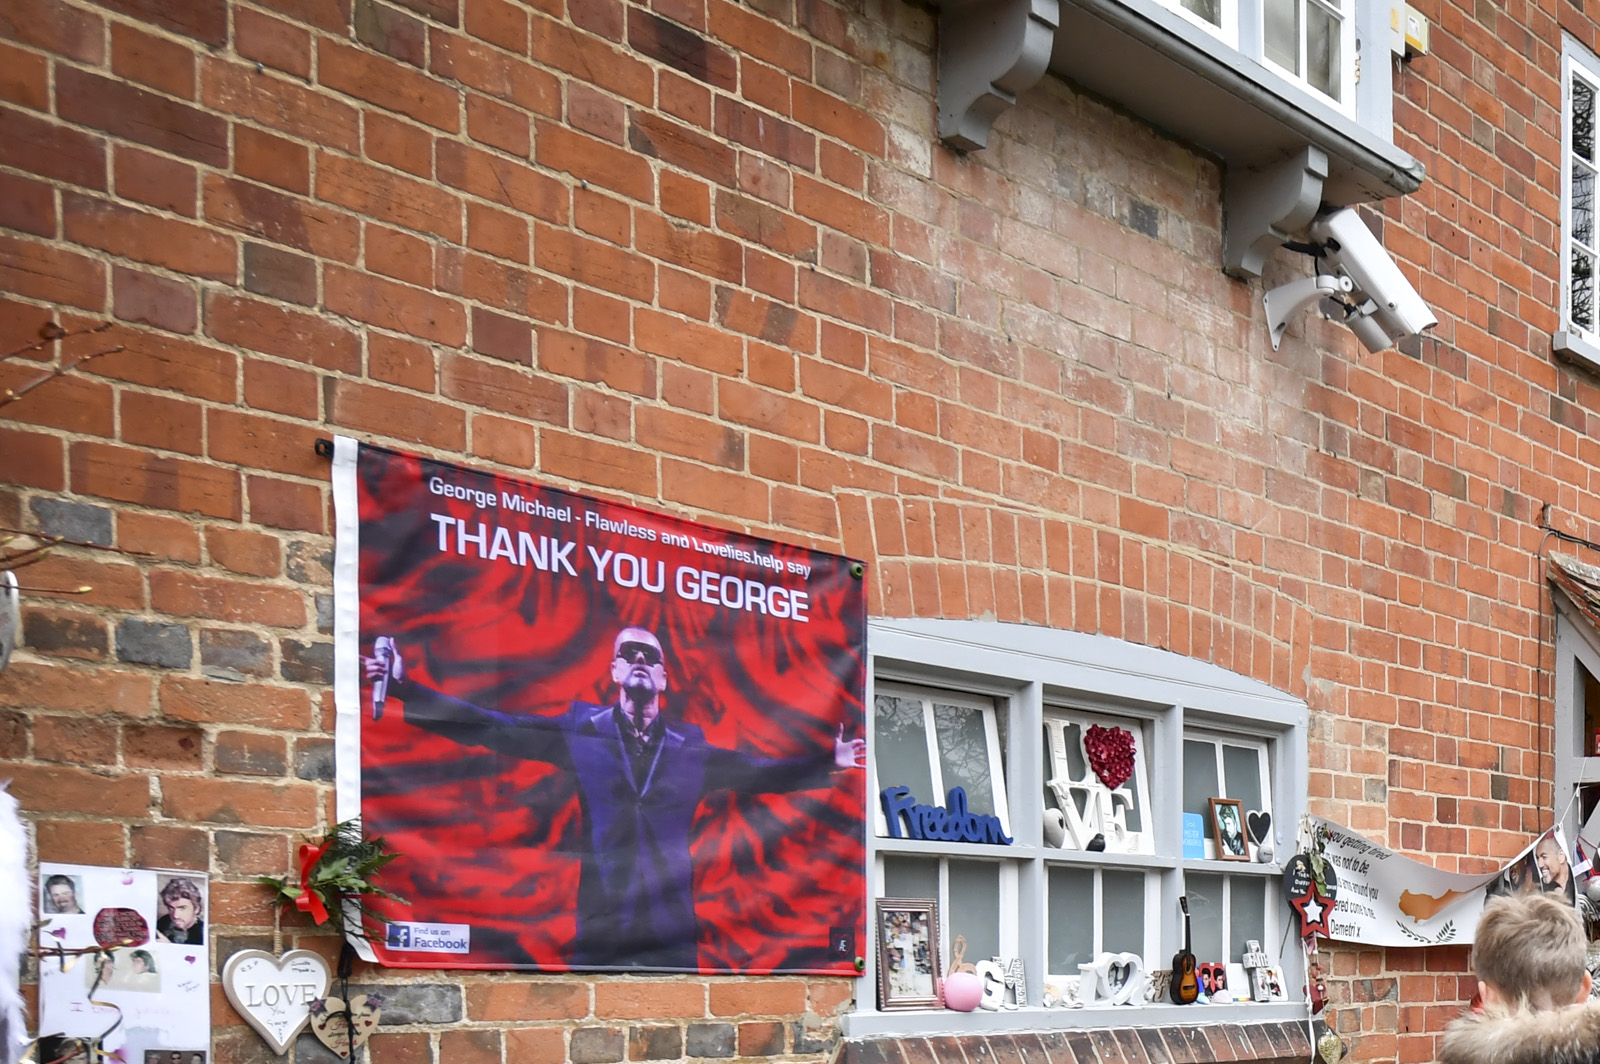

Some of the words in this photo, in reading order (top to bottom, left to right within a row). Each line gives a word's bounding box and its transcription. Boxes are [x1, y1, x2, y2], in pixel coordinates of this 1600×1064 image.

[430, 476, 497, 509] George
[502, 492, 571, 523] Michael
[585, 510, 657, 541] Flawless
[661, 531, 690, 548] and
[691, 536, 784, 574] Lovelies.help
[787, 561, 812, 580] say
[430, 512, 578, 577] THANK
[586, 545, 666, 594] YOU
[676, 565, 810, 623] GEORGE
[880, 785, 1015, 846] Freedom
[1342, 836, 1369, 855] getting
[1368, 845, 1392, 860] tired
[1341, 856, 1353, 869] not
[1352, 856, 1360, 871] to
[1368, 887, 1380, 902] you
[413, 927, 429, 935] Find
[1330, 919, 1356, 936] Demetri
[1355, 926, 1361, 938] x
[414, 936, 467, 949] Facebook
[244, 984, 317, 1008] LOVE
